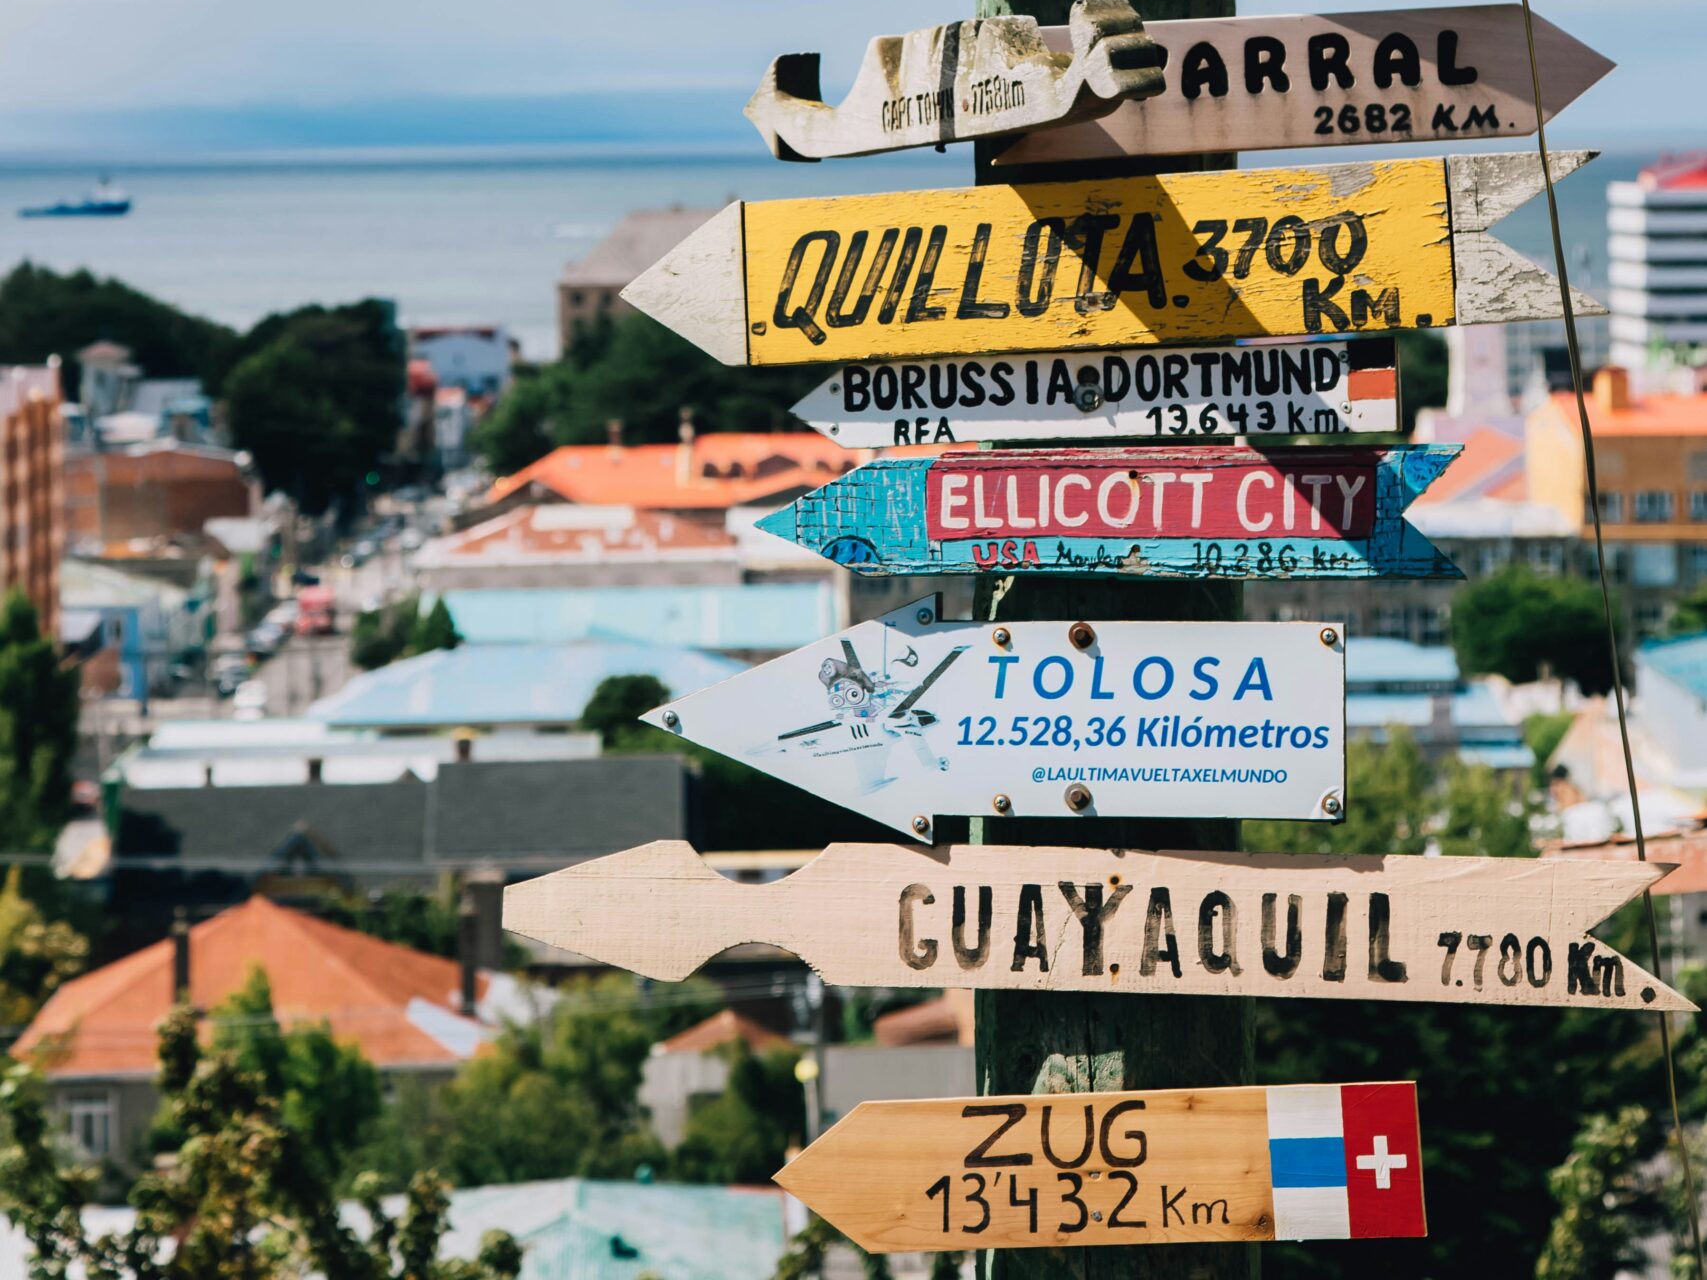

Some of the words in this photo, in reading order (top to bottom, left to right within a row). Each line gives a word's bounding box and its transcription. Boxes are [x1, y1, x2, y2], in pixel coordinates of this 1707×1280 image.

[1137, 30, 1478, 101] ARRAL
[1314, 102, 1412, 135] 2682
[1183, 210, 1368, 281] 3700
[843, 359, 1075, 412] BORUSSIA
[1103, 347, 1341, 402] DORTMUND
[894, 416, 956, 446] RFA
[1146, 401, 1277, 434] 13.643
[940, 470, 1213, 529] ELLICOTT
[1237, 471, 1367, 533] CITY
[972, 540, 1040, 569] USA
[988, 655, 1273, 701] TOLOSA
[957, 715, 1126, 752] 12.528,36
[1136, 715, 1330, 749] Kilómetros
[1032, 767, 1287, 784] @LAULTIMAVUELTAXELMUNDO
[898, 881, 1408, 983] GUAYAQUIL
[962, 1100, 1147, 1169] ZUG
[1161, 1185, 1230, 1227] Km
